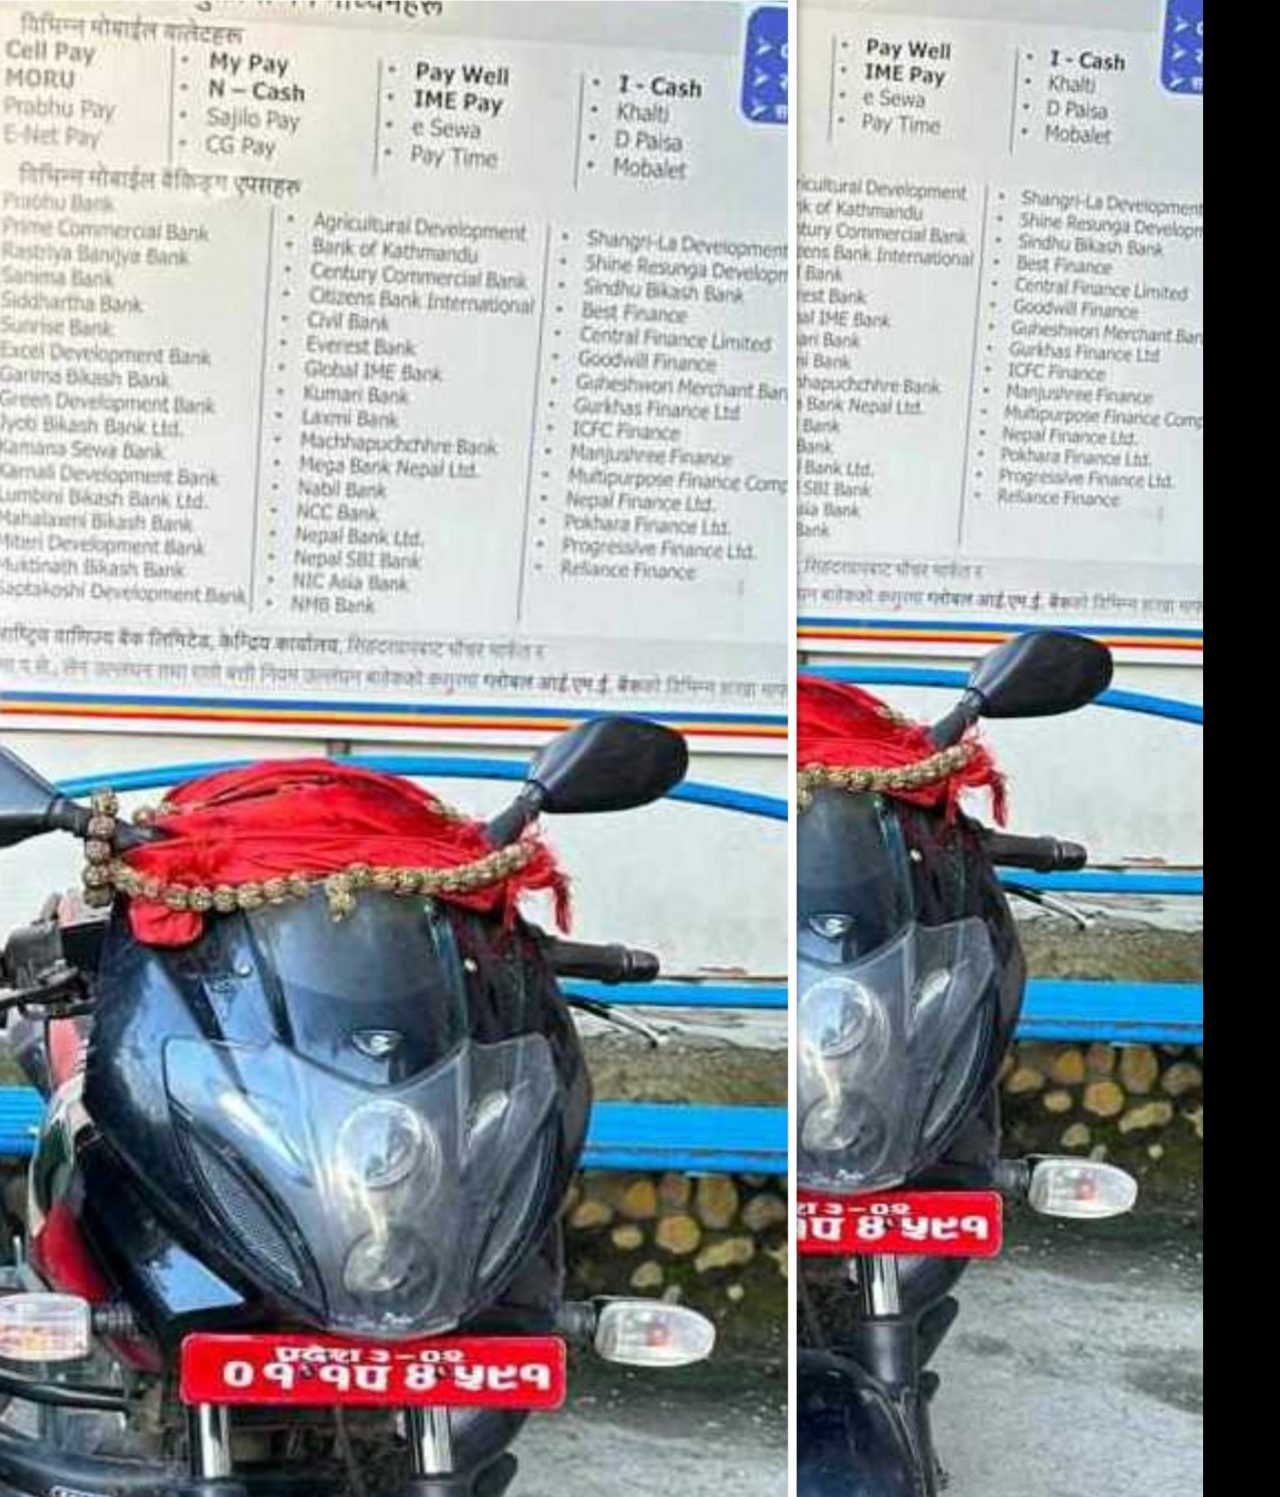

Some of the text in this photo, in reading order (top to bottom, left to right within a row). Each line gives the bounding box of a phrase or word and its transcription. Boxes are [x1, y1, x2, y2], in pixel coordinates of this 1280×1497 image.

[5, 43, 95, 66] Cell Pay
[867, 38, 951, 59] Pay Well
[210, 51, 289, 76] My Pay
[416, 62, 509, 85] Pay Well
[1079, 52, 1125, 72] Cash
[5, 67, 74, 89] MORU
[865, 64, 946, 87] IME Pay
[1048, 74, 1096, 93] Khalti
[209, 79, 225, 98] N
[253, 82, 305, 102] Cash
[651, 77, 702, 99] Cash
[863, 90, 925, 108] e Sewa
[4, 97, 116, 122] Prabhu Pay
[414, 90, 504, 116] IME Pay
[617, 102, 669, 123] Khalti
[1048, 100, 1108, 121] D Paisa
[207, 107, 300, 133] Sajilo Pay
[412, 119, 481, 139] e Sewa
[862, 114, 941, 135] Pay Time
[4, 124, 100, 150] E-Net Pay
[616, 130, 683, 153] D Paisa
[1045, 124, 1112, 146] Mobalet
[206, 135, 276, 159] CG Pay
[411, 146, 498, 169] Pay Time
[613, 157, 687, 181] Mobalet
[314, 211, 527, 242] Agricultural Development
[312, 237, 478, 264] Bank of Kathmandu
[587, 229, 678, 252] Shangri-La
[310, 261, 527, 290] Century Commercial Bank
[585, 254, 633, 273] Shine
[638, 258, 707, 281] Resunga
[308, 286, 535, 315] Citizens Bank International
[584, 277, 744, 304] Sindhu Bikash Bank
[582, 301, 688, 324] Best Finance
[306, 336, 417, 356] Everest Bank
[580, 325, 773, 353] Central Finance Limited
[304, 359, 442, 383] Global IME Bank
[578, 350, 718, 373] Goodwill Finance
[303, 384, 409, 405] Kumari Bank
[297, 503, 378, 522] NCC Bank
[296, 526, 343, 546] Nepal
[348, 528, 388, 547] Bank
